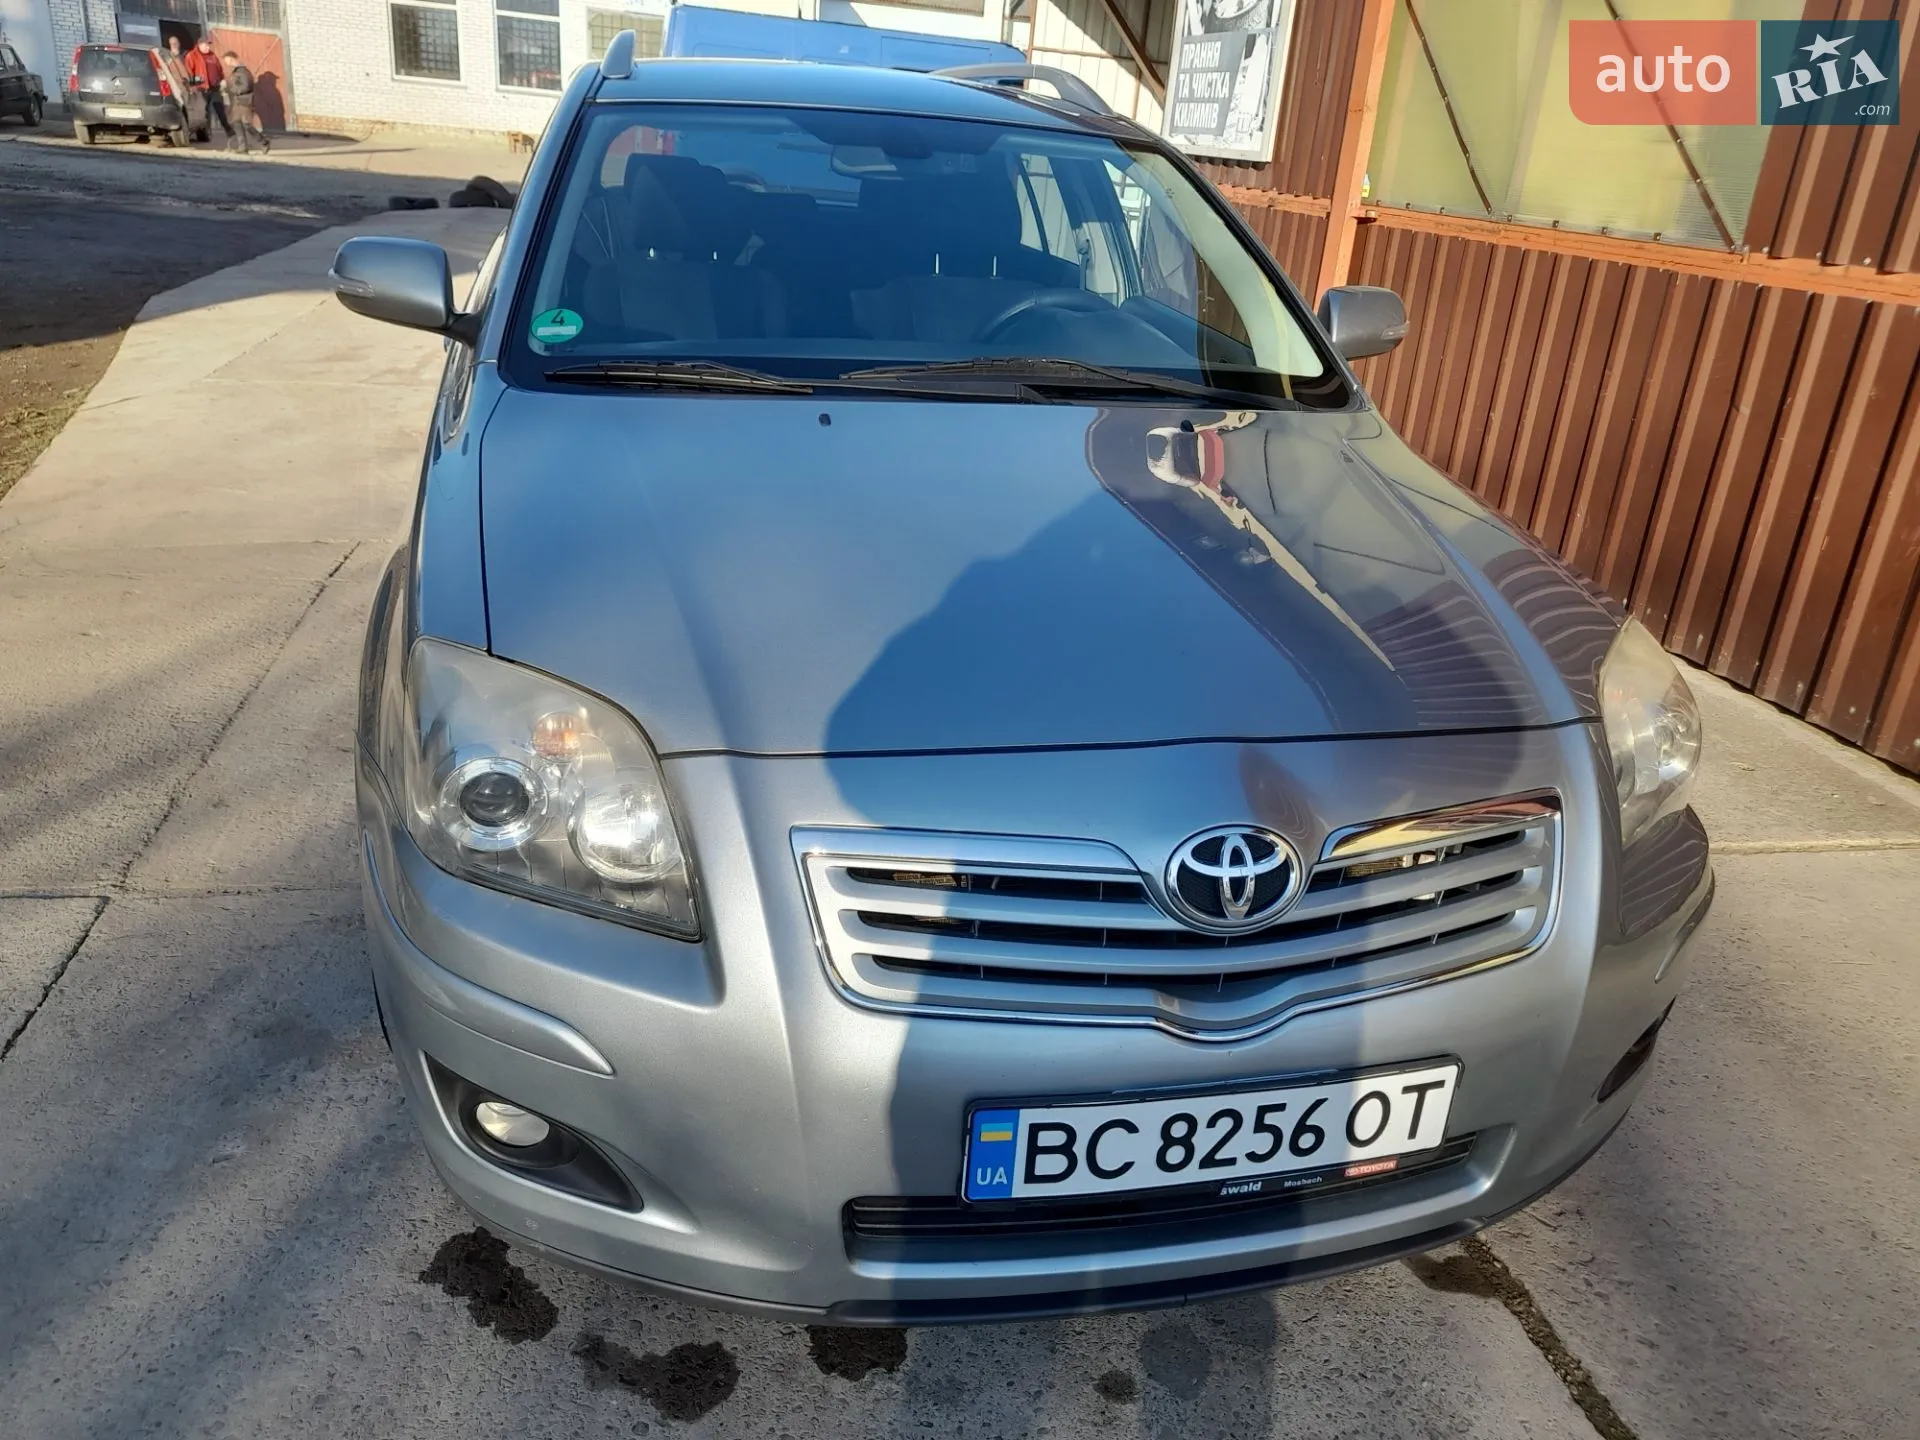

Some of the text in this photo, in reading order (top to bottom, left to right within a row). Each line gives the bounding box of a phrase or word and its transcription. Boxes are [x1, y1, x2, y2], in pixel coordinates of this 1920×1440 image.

[1180, 41, 1222, 69] ПРАННЯ
[1178, 72, 1230, 98] ТА ЧИСТКА
[1174, 102, 1219, 128] КИЛИМІВ
[550, 309, 566, 326] 4
[1023, 1079, 1446, 1184] BC 8256 OT
[976, 1166, 1008, 1186] UA
[1359, 1159, 1398, 1174] TOYOTA
